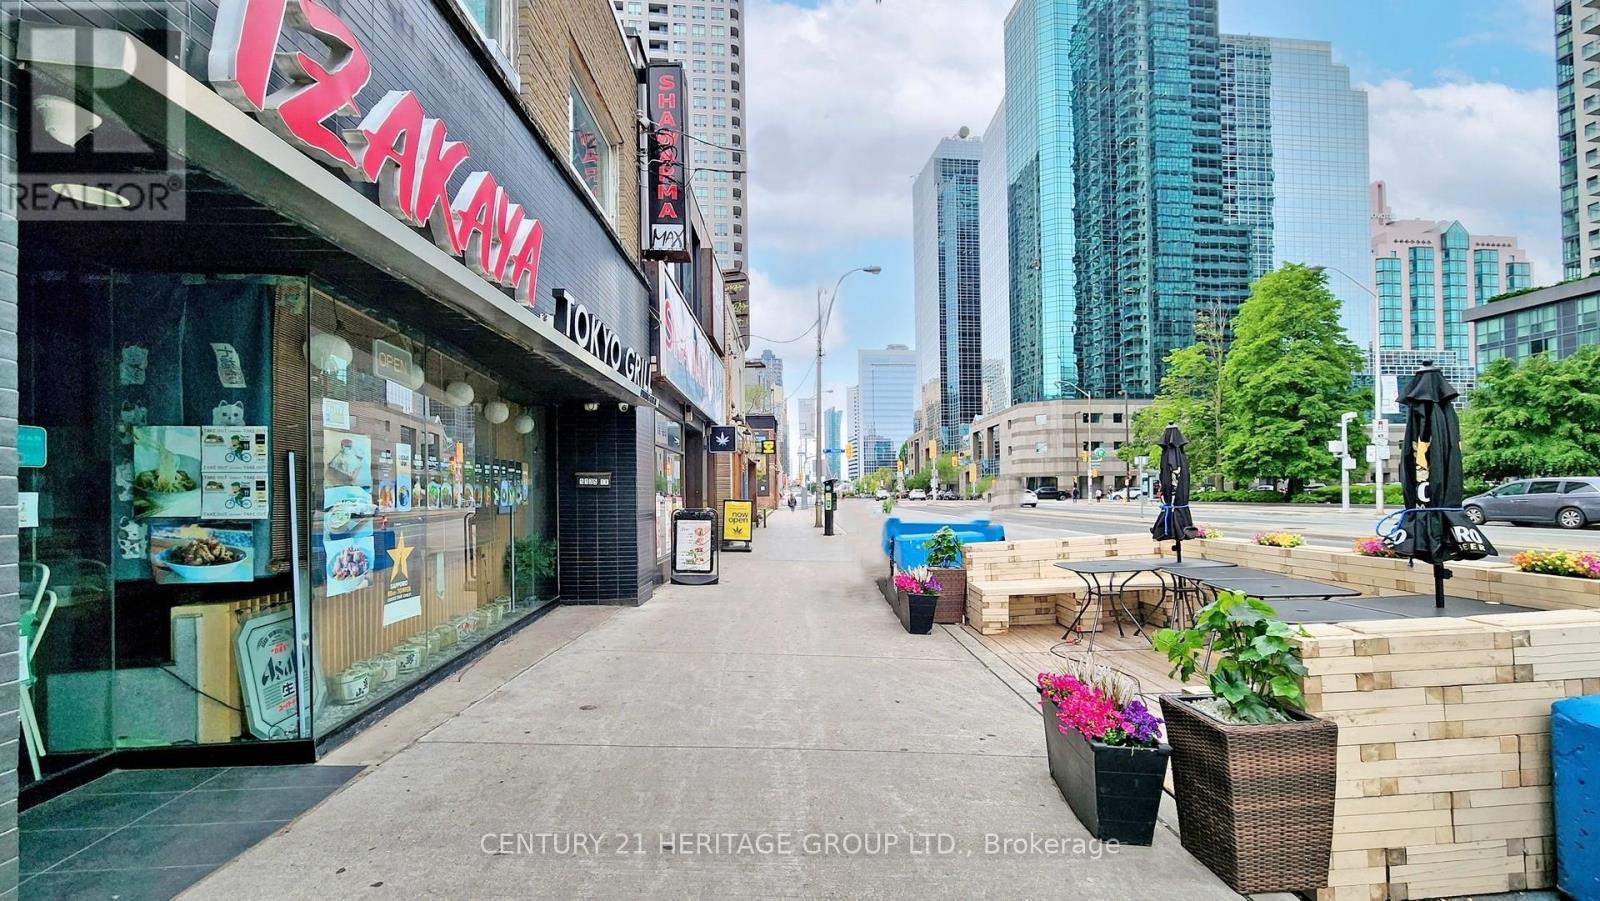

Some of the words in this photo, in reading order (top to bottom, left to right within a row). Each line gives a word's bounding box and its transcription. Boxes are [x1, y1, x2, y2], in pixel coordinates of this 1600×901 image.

[653, 227, 685, 251] MAX
[552, 288, 621, 371] TOKYO
[624, 346, 653, 395] GRILL
[728, 517, 748, 525] open
